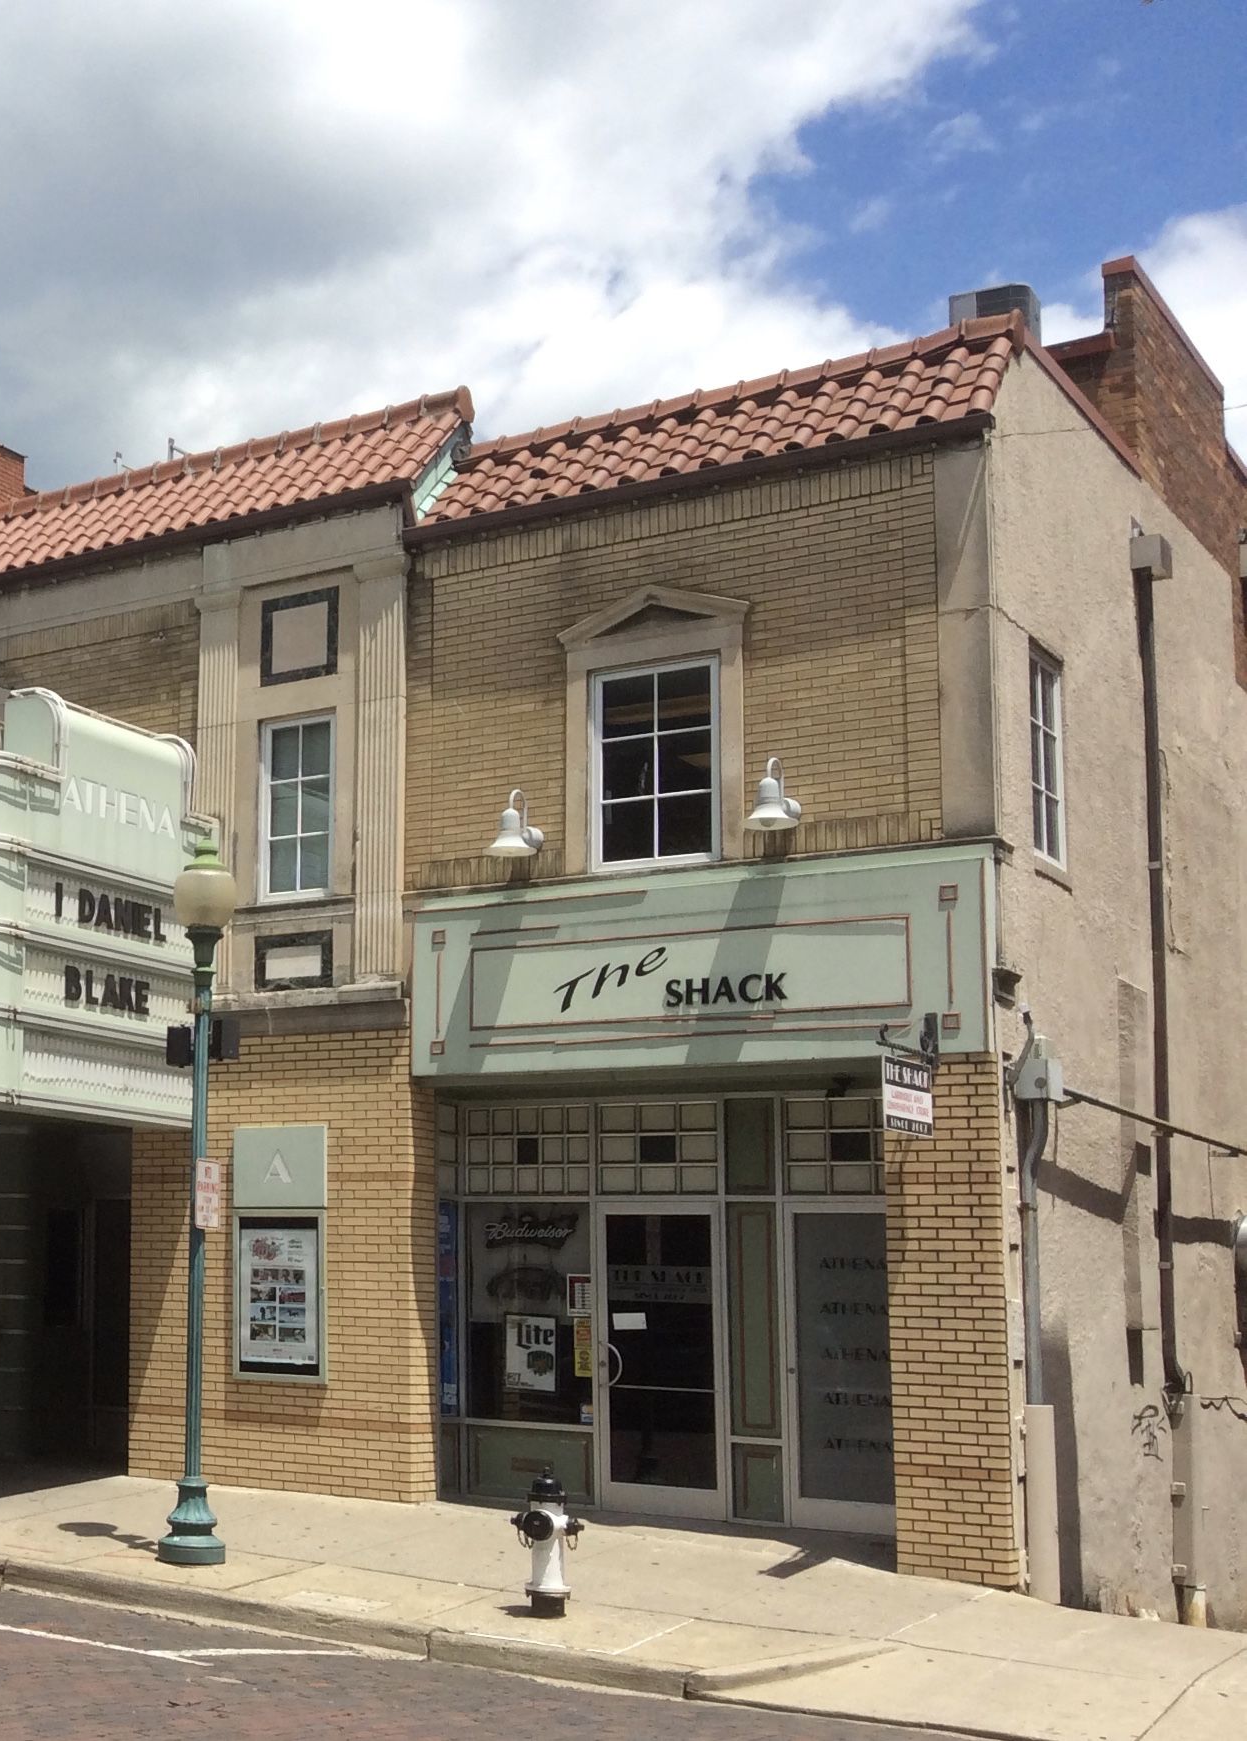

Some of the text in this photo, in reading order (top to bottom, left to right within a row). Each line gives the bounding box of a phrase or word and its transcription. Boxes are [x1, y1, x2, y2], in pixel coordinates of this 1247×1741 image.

[63, 775, 176, 839] ATHENA
[55, 882, 167, 942] I DANIEL
[64, 965, 151, 1015] BLAKE
[553, 946, 787, 1013] The SHACK
[885, 1062, 929, 1089] THE SHACK
[263, 1148, 292, 1184] A
[483, 1222, 574, 1240] Budweiser
[516, 1322, 554, 1350] Lite
